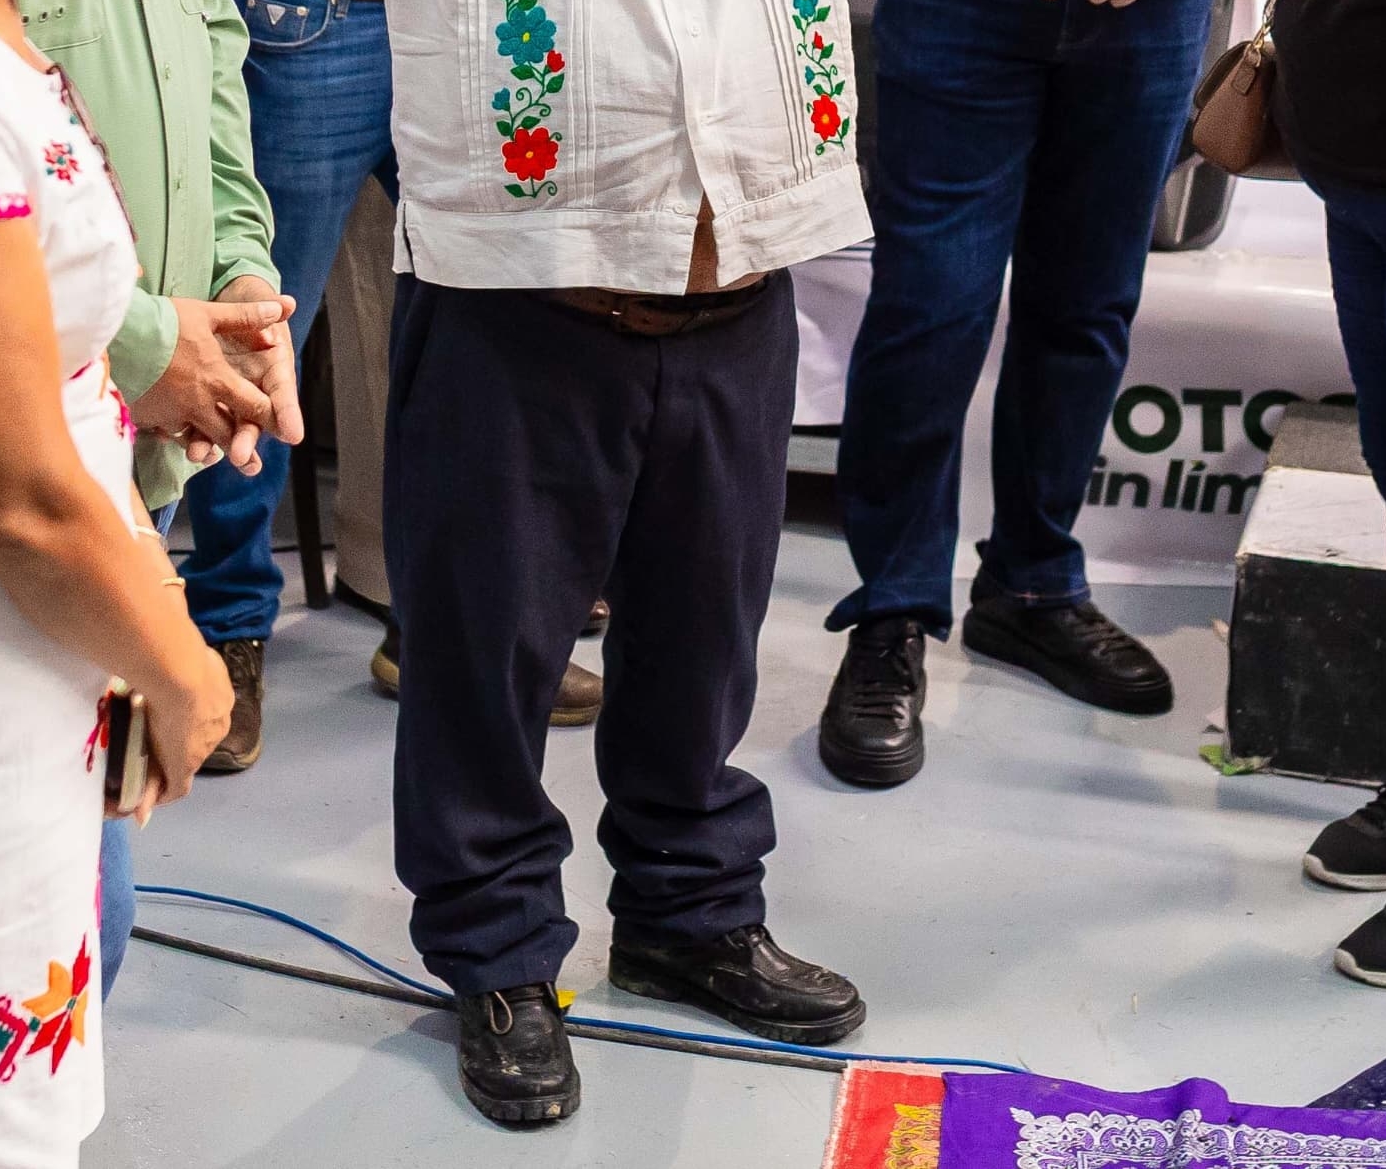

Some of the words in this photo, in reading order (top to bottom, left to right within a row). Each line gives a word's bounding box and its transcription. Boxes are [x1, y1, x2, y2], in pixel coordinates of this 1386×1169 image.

[1112, 384, 1357, 455] OTO
[1086, 455, 1150, 509] in
[1163, 458, 1262, 515] lím
